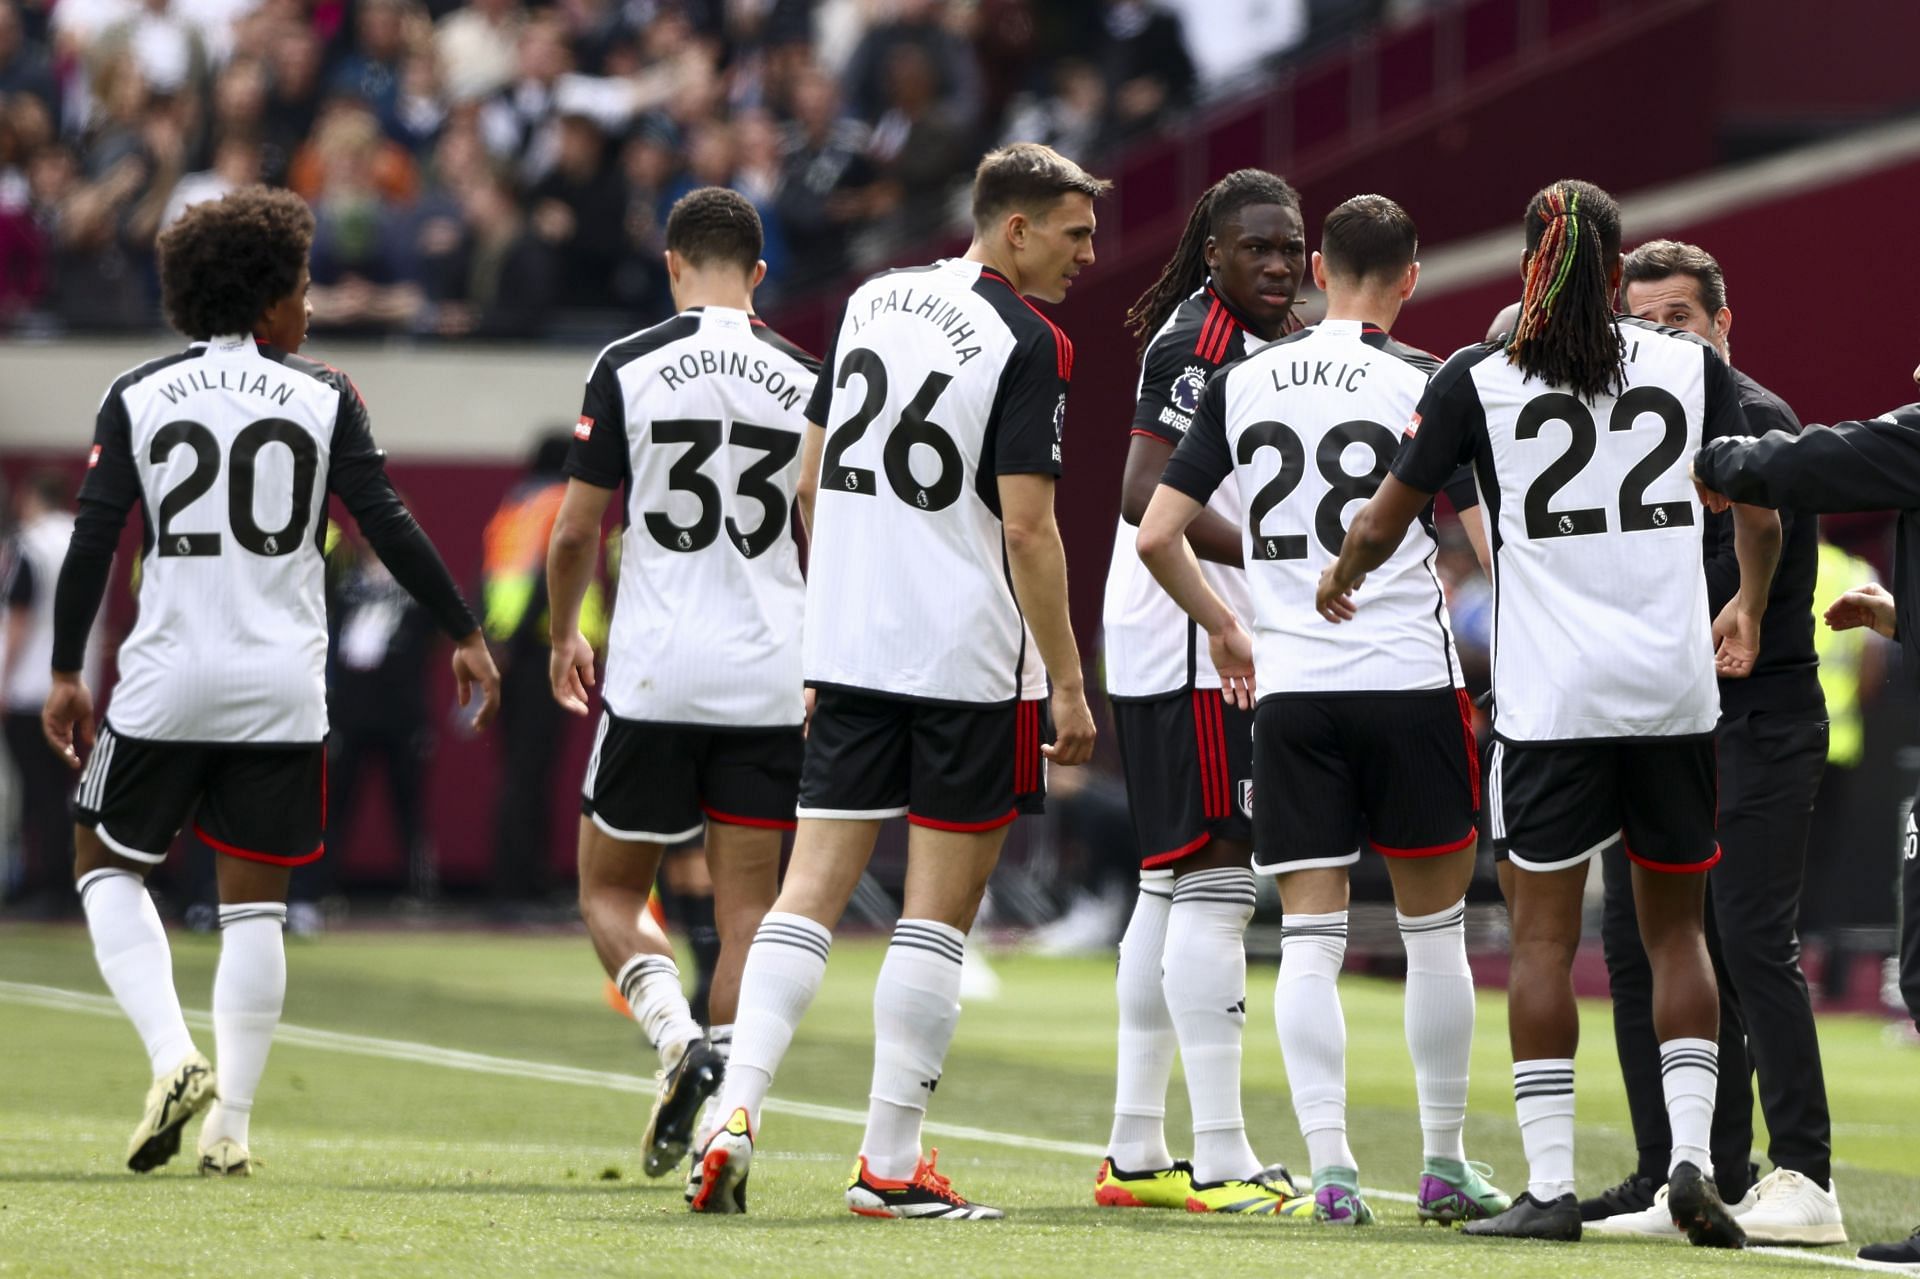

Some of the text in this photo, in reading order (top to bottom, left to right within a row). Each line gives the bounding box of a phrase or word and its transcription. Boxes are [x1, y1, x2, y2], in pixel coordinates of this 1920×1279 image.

[159, 369, 296, 407] WILLIAN
[659, 350, 801, 411] ROBINSON
[850, 288, 982, 367] J. PALHINHA
[1271, 361, 1369, 393] LUKIĆ
[150, 417, 319, 557] 20
[644, 418, 802, 560] 33
[820, 348, 964, 512] 26
[1236, 420, 1401, 560] 28
[1514, 386, 1694, 539] 22
